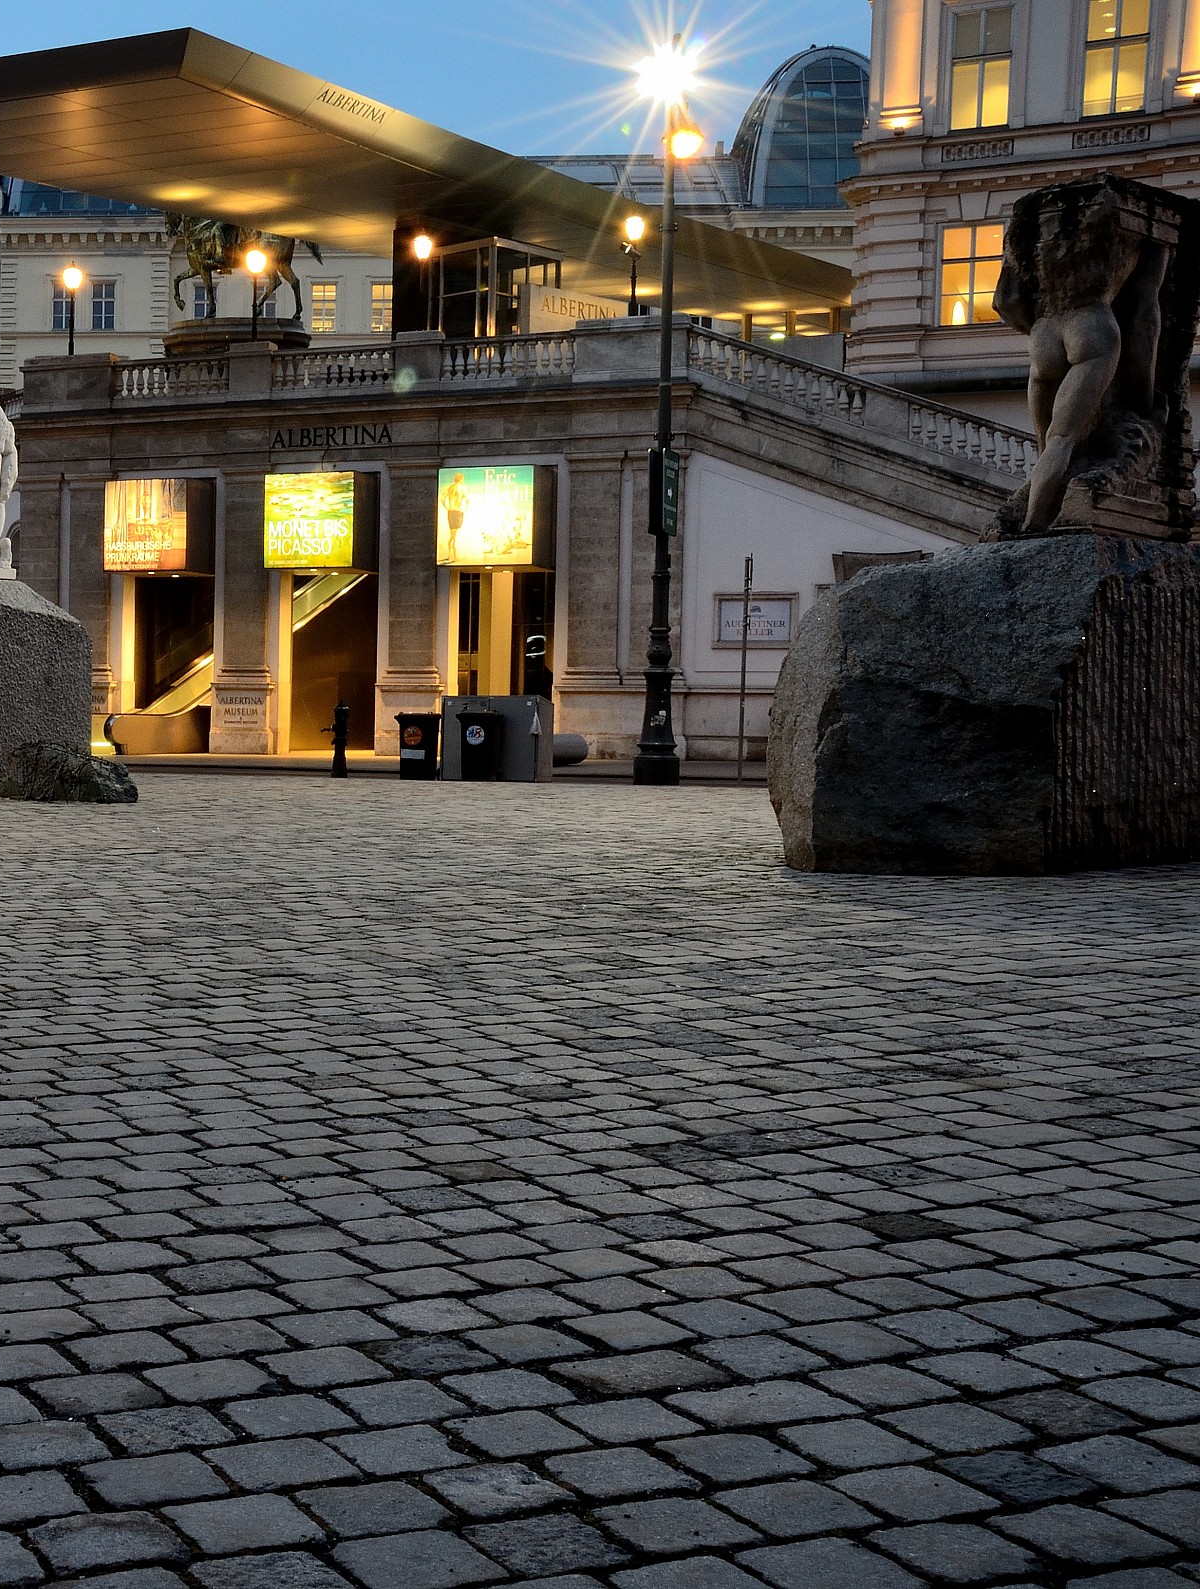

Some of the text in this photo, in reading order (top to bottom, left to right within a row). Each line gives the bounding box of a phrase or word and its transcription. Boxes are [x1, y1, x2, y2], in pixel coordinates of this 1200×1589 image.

[316, 88, 387, 124] ALBERTINA
[270, 423, 393, 449] ALBERTINA
[484, 468, 516, 485] Eric
[268, 518, 348, 537] MONET BIS
[105, 539, 171, 552] HABSBURGISCHE
[268, 537, 332, 556] PICASSO
[724, 620, 786, 628] AUGSTINER
[219, 696, 263, 706] ALBERTINA
[223, 708, 258, 716] MUSEUM
